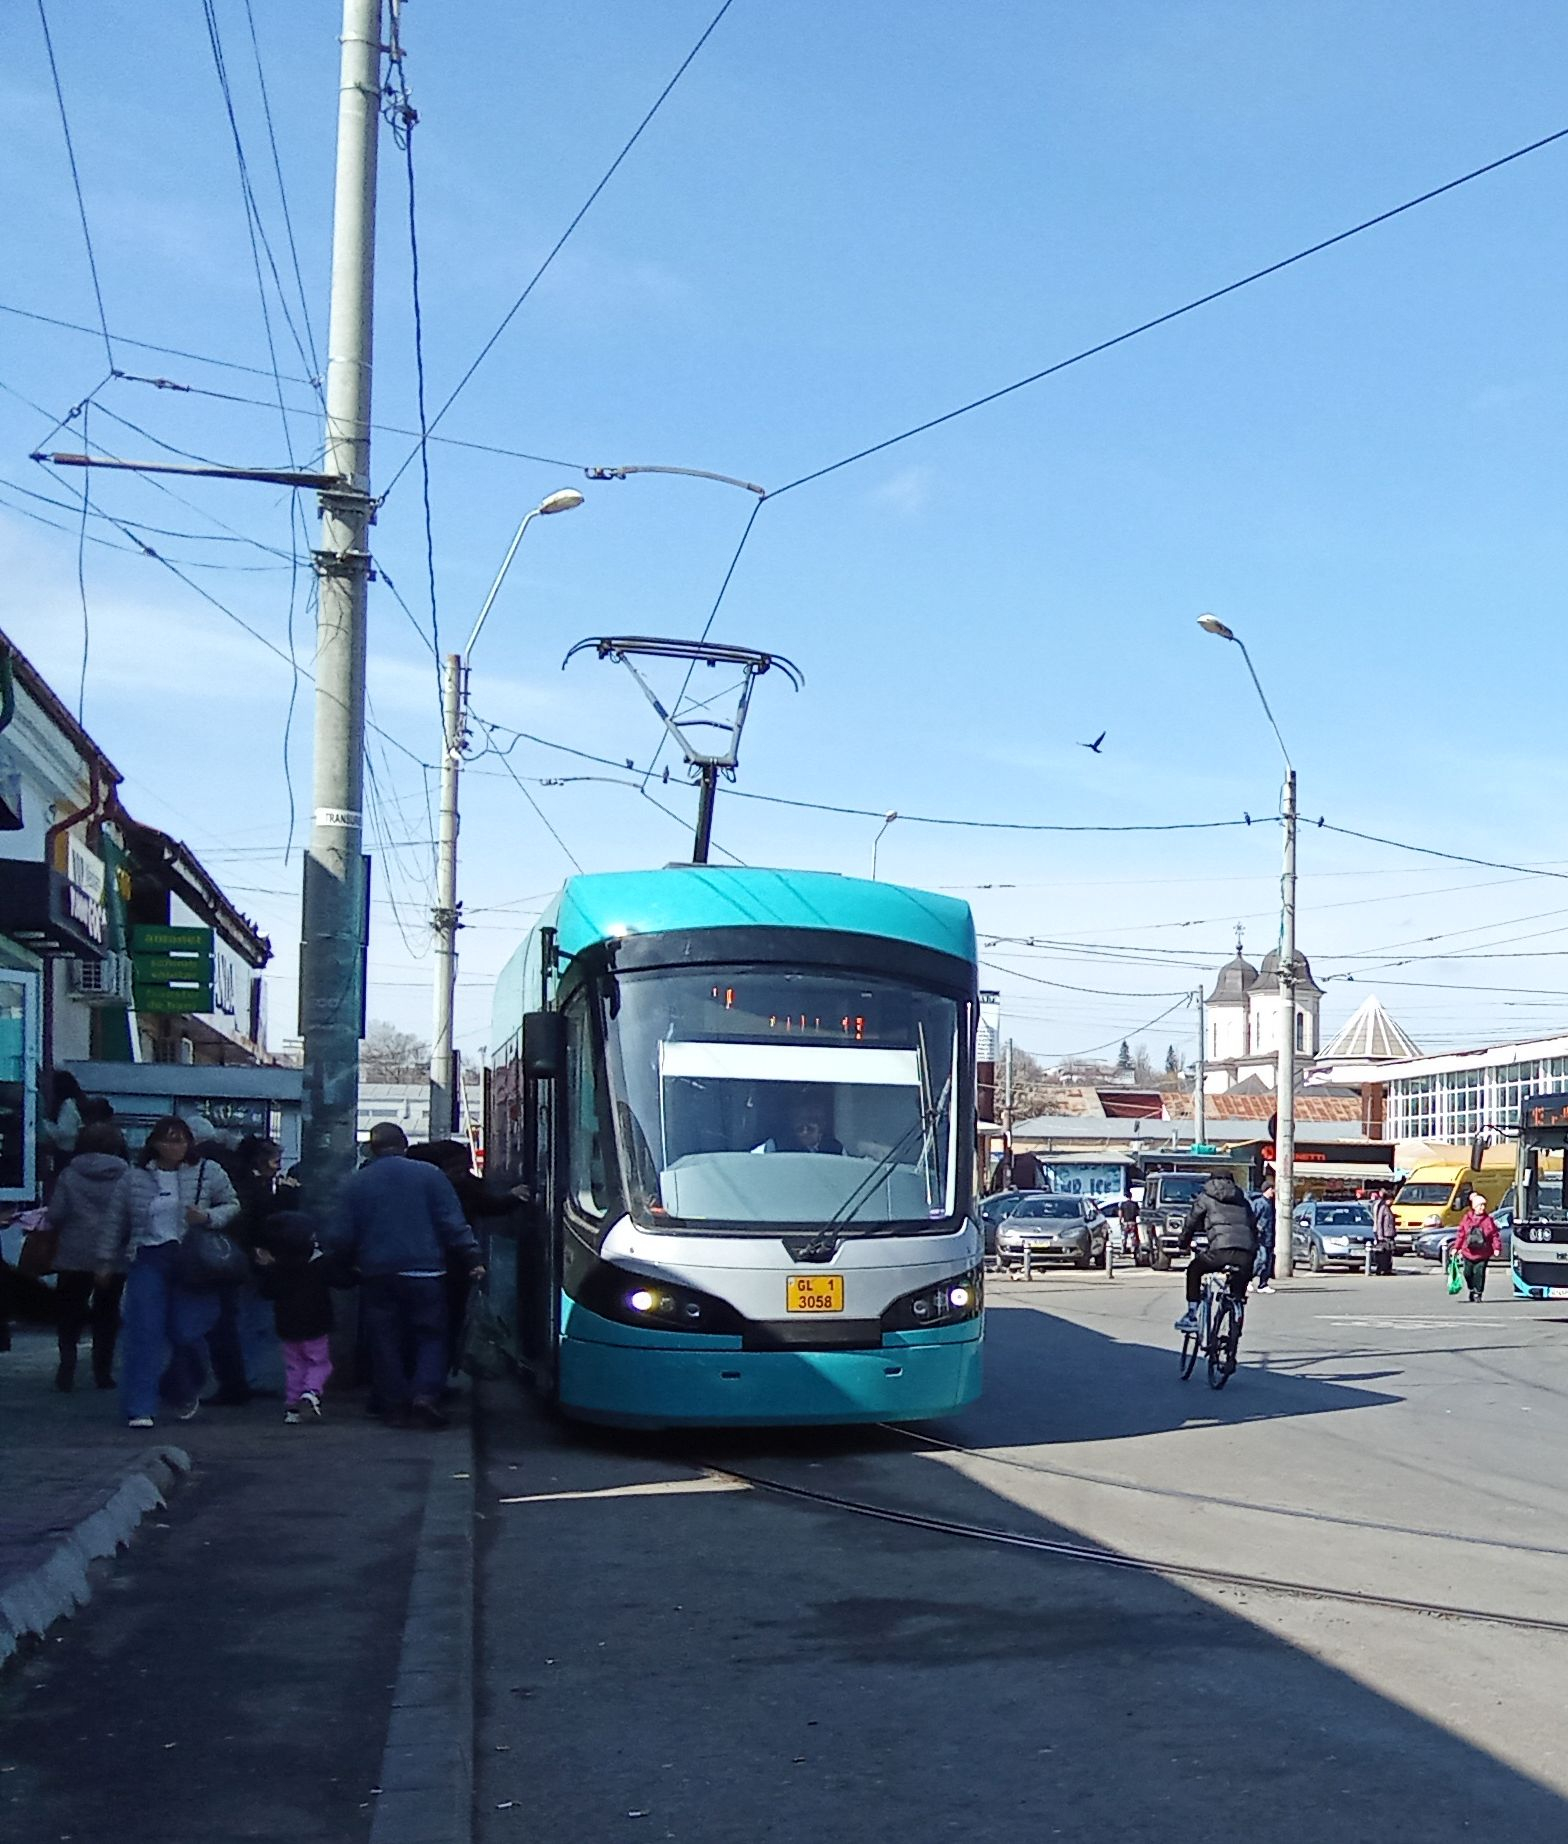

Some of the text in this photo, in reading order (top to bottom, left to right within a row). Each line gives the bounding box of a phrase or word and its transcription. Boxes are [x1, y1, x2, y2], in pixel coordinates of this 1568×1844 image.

[798, 1279, 834, 1292] GL 1
[798, 1296, 833, 1309] 3058
